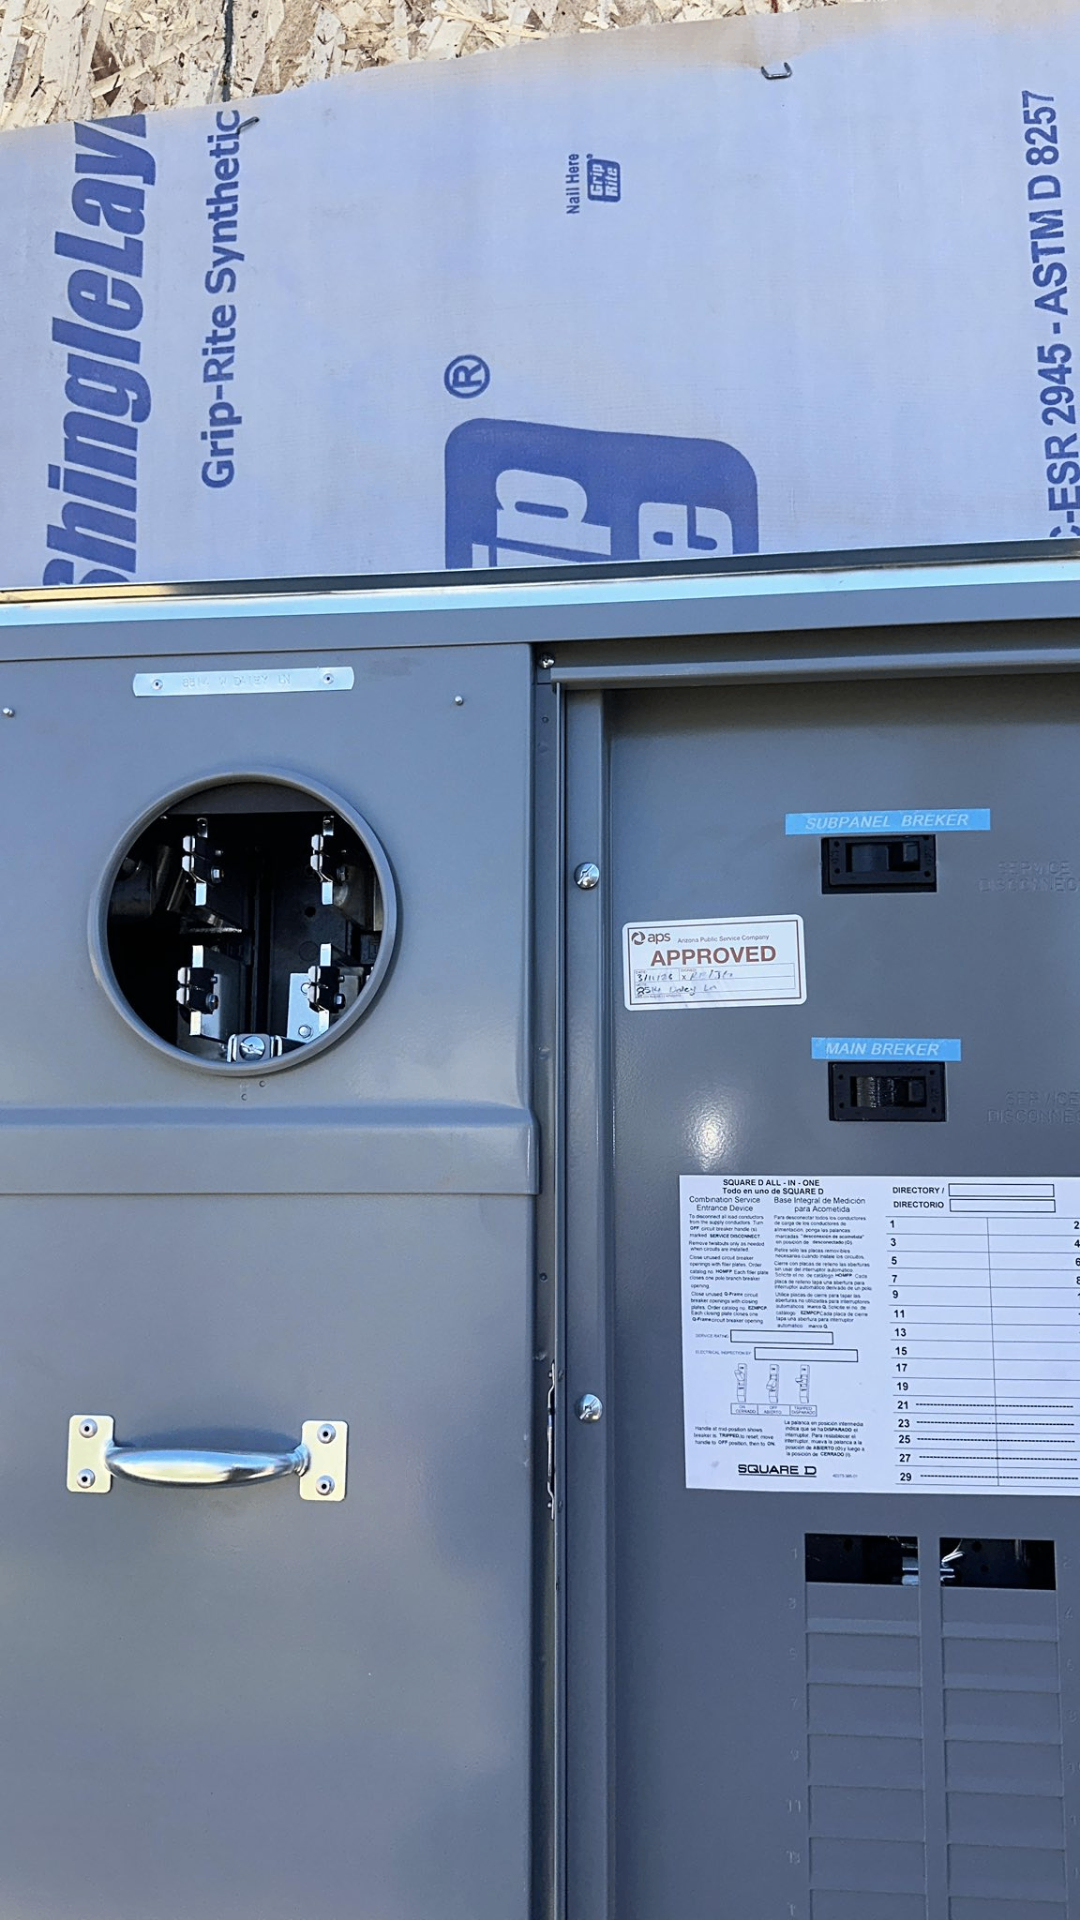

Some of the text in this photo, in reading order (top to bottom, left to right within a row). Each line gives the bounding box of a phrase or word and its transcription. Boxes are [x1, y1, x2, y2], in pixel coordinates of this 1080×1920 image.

[1021, 90, 1059, 165] 8257
[565, 153, 580, 214] Nail Here
[590, 164, 605, 196] Grip
[605, 167, 618, 197] Rite
[1027, 175, 1061, 200] D
[1029, 209, 1068, 315] ASTM
[201, 109, 245, 489] Grip-Rite Synthetic
[1037, 343, 1076, 426] 2945
[806, 813, 969, 830] SUBPANEL BREKER
[647, 932, 671, 945] aps
[741, 934, 769, 942] Company
[650, 946, 776, 966] APPROVED
[826, 1042, 939, 1057] MAIN BREKER
[788, 1179, 796, 1187] IN
[803, 1179, 820, 1187] ONE
[794, 1197, 820, 1205] Integral
[890, 1220, 895, 1228] 1
[1074, 1221, 1080, 1229] 2
[890, 1238, 896, 1246] 3
[1074, 1239, 1080, 1248] 4
[891, 1256, 897, 1265] 5
[1075, 1258, 1080, 1266] 6
[892, 1290, 898, 1299] 9
[894, 1310, 905, 1318] 11
[895, 1329, 906, 1337] 13
[895, 1347, 907, 1355] 15
[896, 1364, 908, 1372] 17
[897, 1382, 908, 1390] 19
[897, 1401, 908, 1409] 21
[898, 1419, 910, 1428] 23
[899, 1435, 911, 1444] 25
[899, 1454, 911, 1462] 27
[738, 1464, 817, 1475] SQUARE D
[900, 1473, 912, 1481] 29
